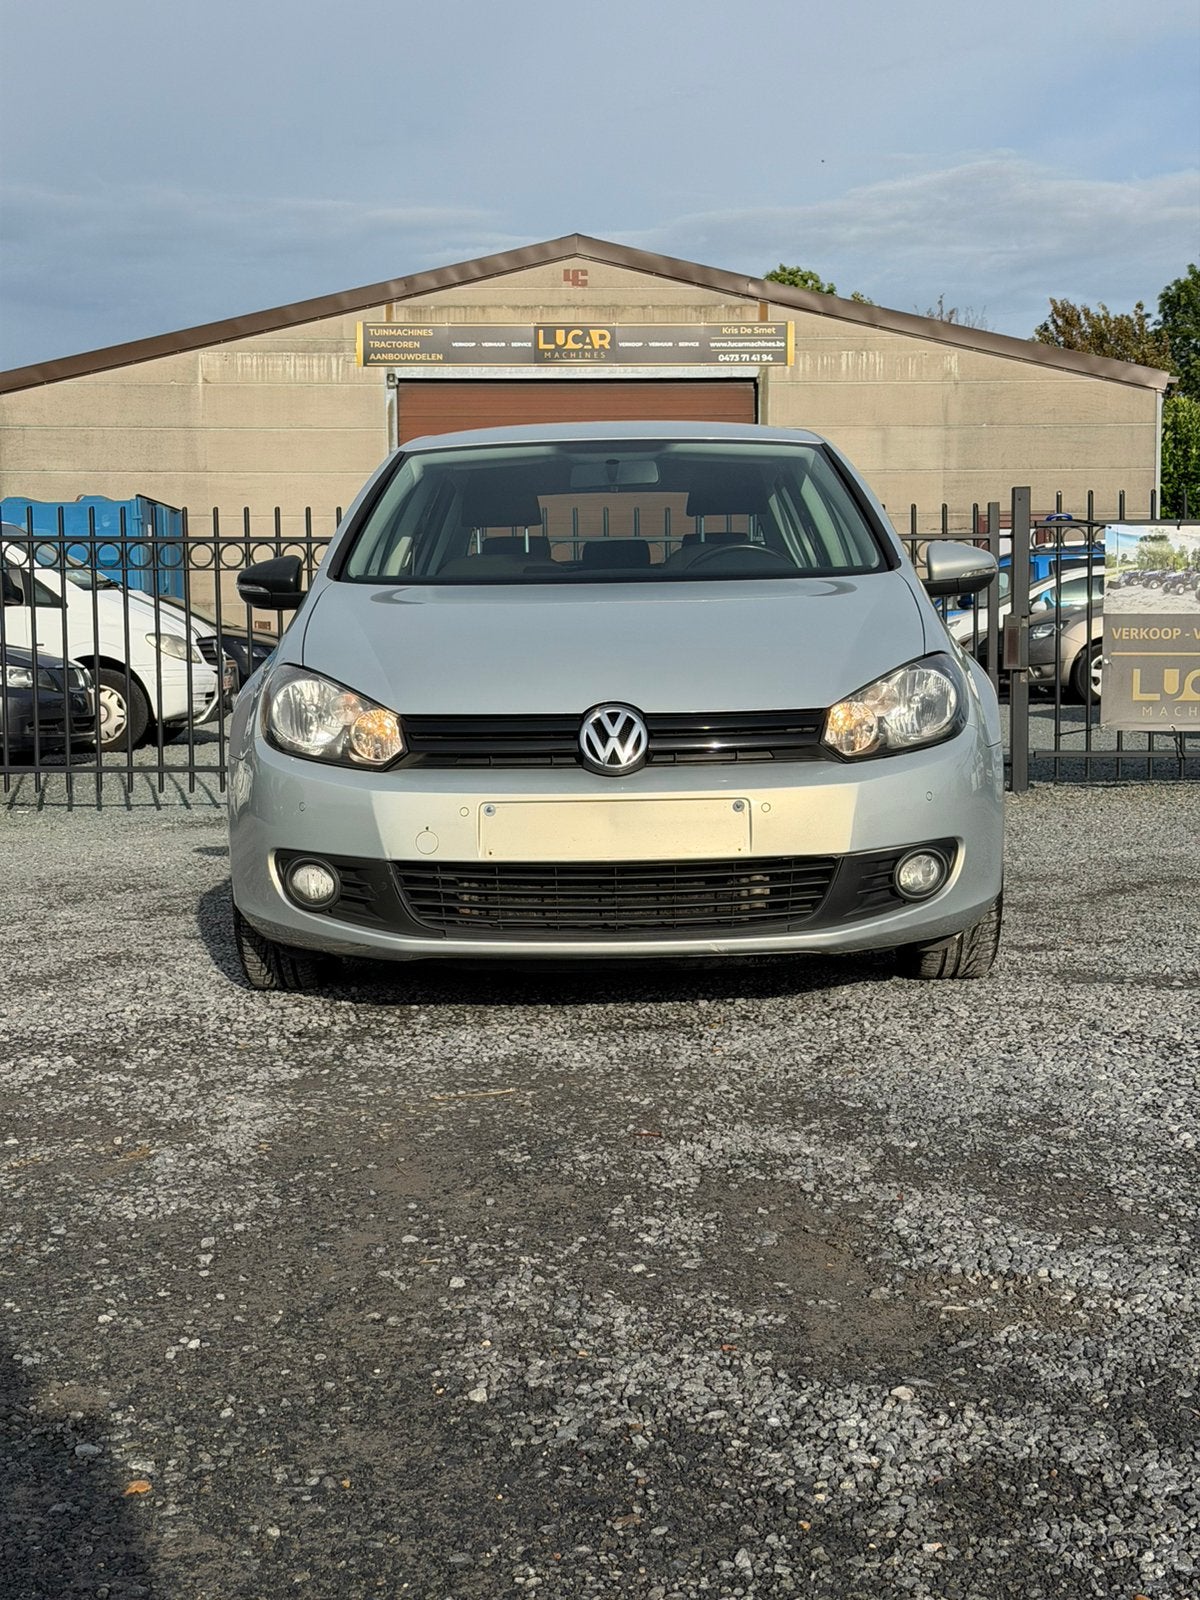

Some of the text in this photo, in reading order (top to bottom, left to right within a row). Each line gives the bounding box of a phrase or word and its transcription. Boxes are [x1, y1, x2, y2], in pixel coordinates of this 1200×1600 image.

[369, 328, 434, 337] TUINMACHINES
[722, 326, 738, 334] Kris
[753, 326, 776, 334] Smet
[538, 329, 611, 350] LUCAR
[369, 341, 420, 349] TRACTOREN
[709, 340, 786, 348] www.lucarmachines.be
[369, 353, 444, 361] AANBOUWDELEN
[544, 351, 606, 359] MACHINES
[718, 354, 773, 362] 0473 71 41 94
[1112, 627, 1181, 640] VERKOOP
